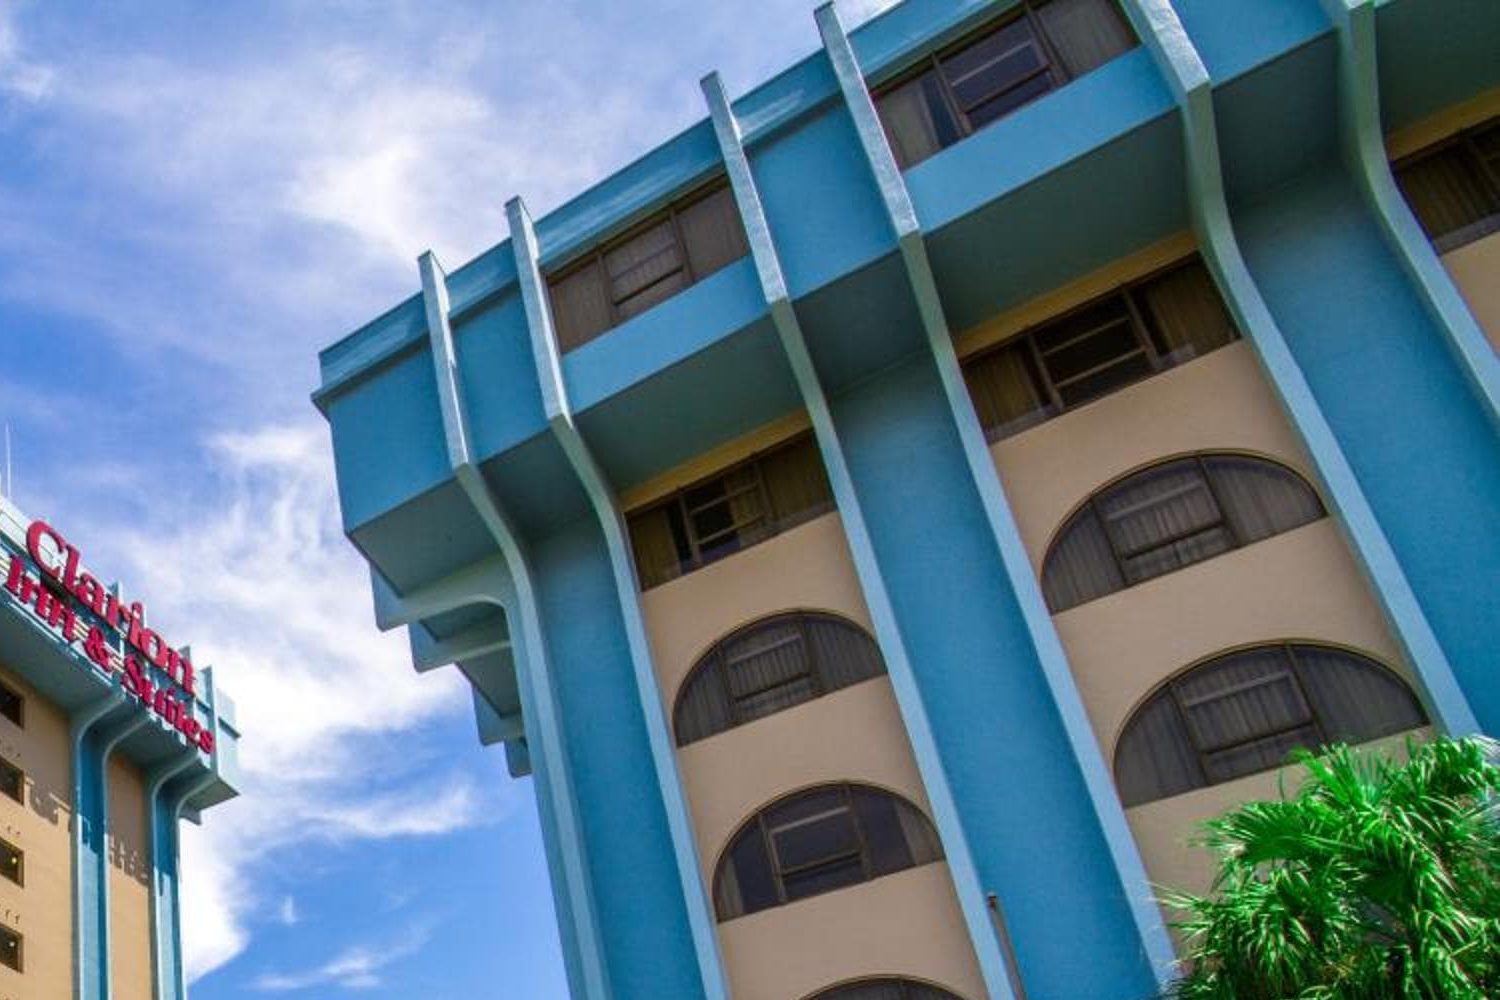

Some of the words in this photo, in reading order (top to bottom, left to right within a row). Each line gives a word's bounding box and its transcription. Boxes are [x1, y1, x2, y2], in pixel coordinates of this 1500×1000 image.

[6, 555, 78, 642] Inn
[83, 625, 112, 672] &
[121, 654, 214, 754] Suites
[26, 520, 196, 697] Clarion
